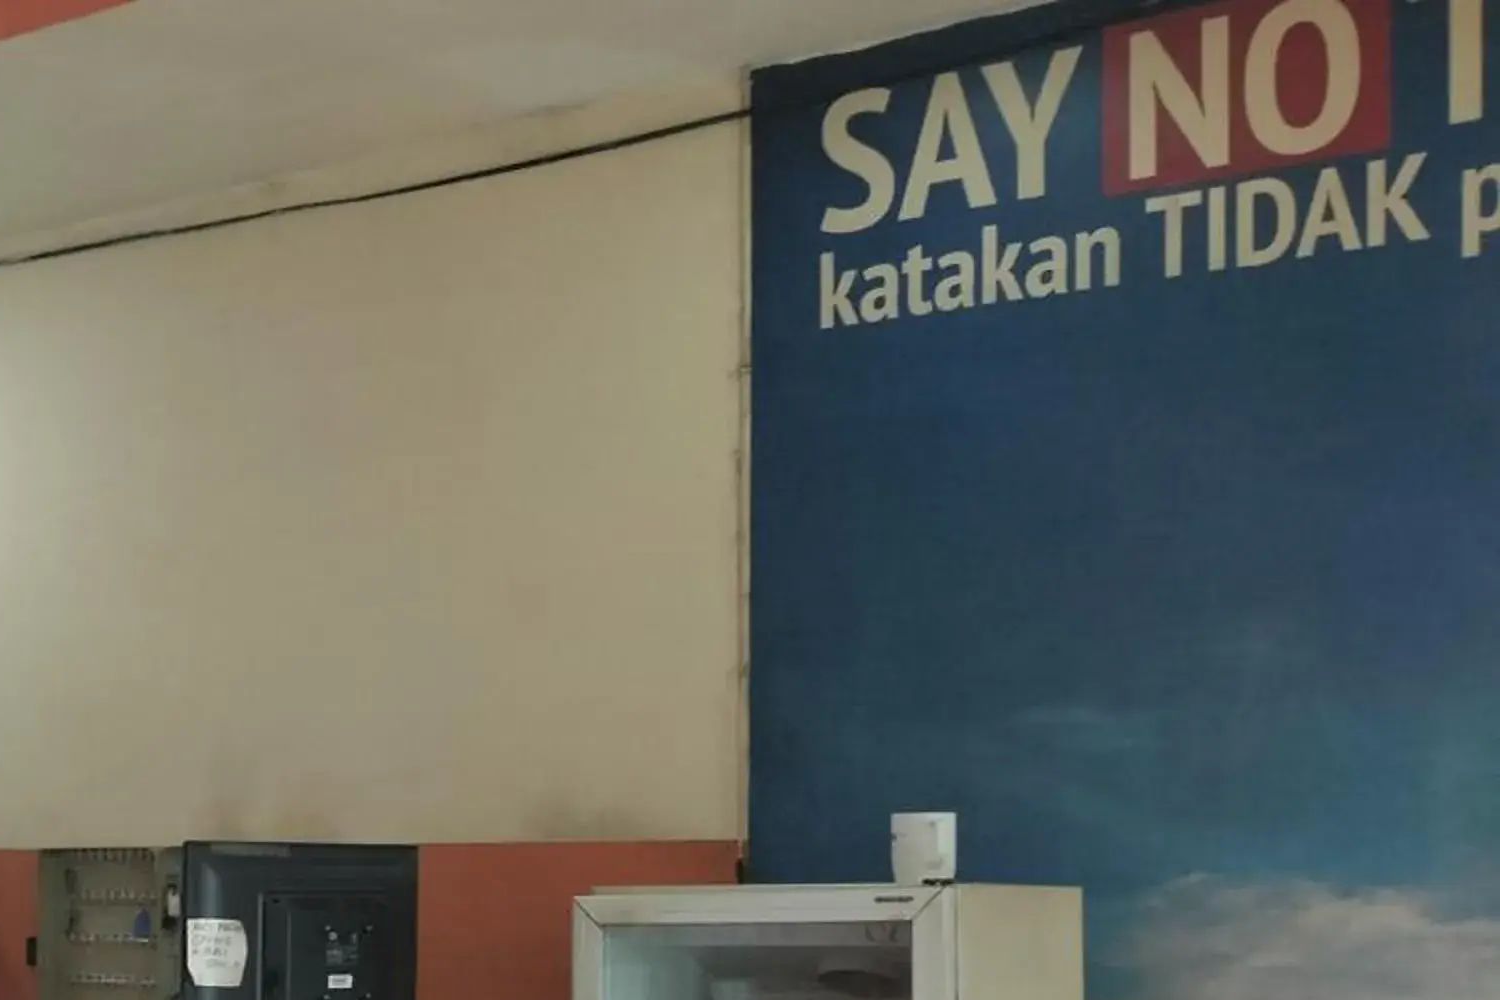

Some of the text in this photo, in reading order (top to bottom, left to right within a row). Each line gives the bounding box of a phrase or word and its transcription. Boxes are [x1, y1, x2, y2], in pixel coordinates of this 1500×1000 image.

[820, 46, 1084, 234] SAY
[1128, 0, 1362, 181] NO
[820, 224, 1120, 329] katakan
[1145, 151, 1431, 278] TIDAK
